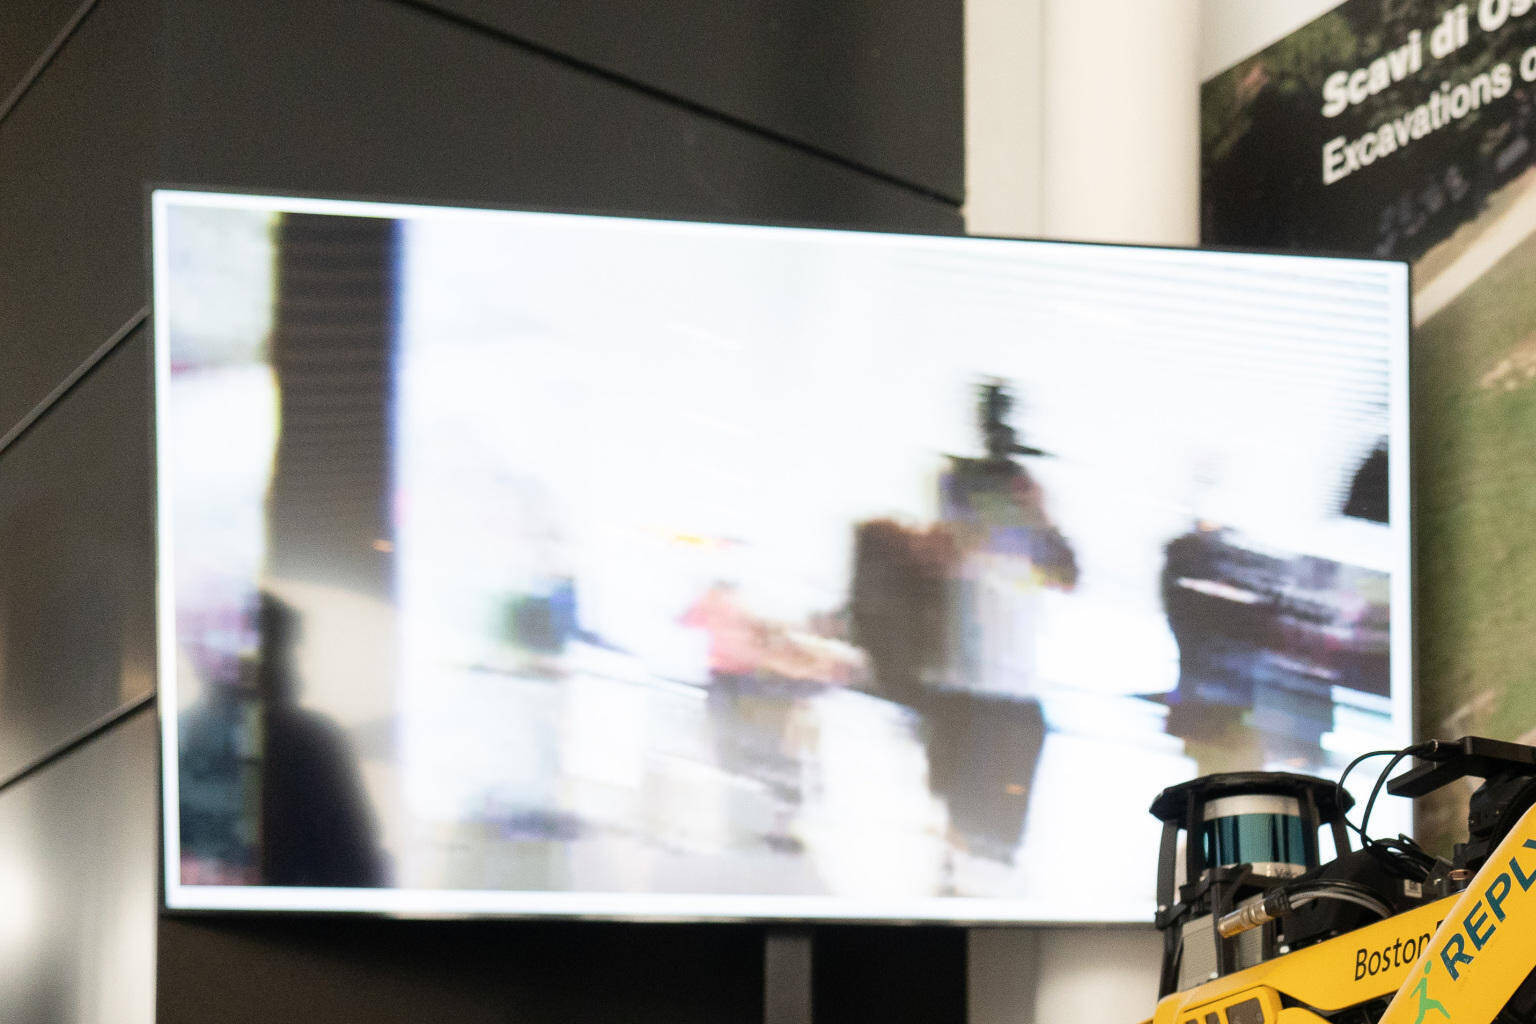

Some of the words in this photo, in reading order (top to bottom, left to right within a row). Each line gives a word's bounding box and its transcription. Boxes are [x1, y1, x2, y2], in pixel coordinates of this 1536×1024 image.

[1321, 29, 1422, 118] Scavi
[1430, 3, 1469, 59] di
[1322, 63, 1512, 186] Excavations
[1354, 932, 1431, 982] Boston
